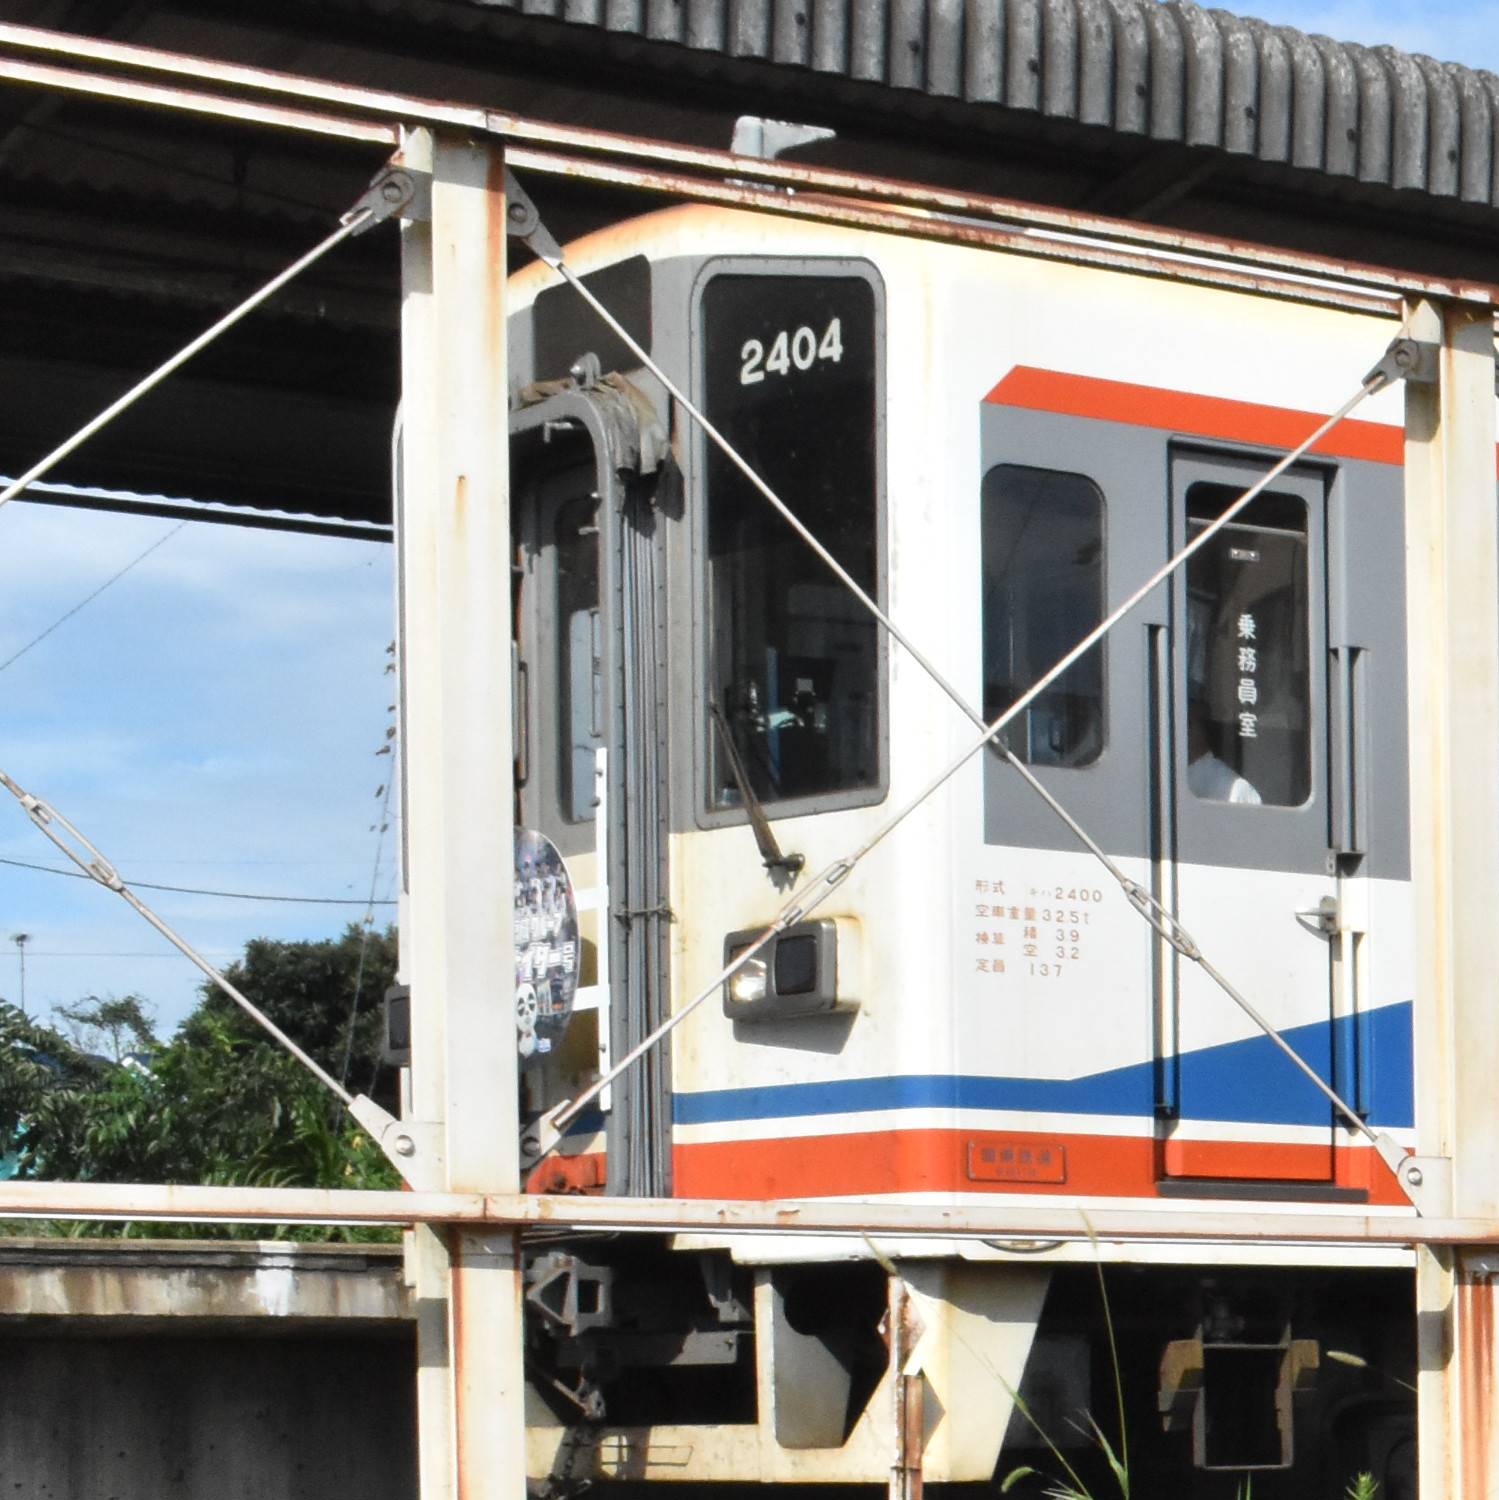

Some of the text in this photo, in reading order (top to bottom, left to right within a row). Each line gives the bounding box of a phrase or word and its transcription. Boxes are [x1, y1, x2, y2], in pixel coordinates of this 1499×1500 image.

[740, 317, 843, 385] 2404
[1236, 613, 1258, 739] 乗務員室
[1030, 962, 1064, 977] 137
